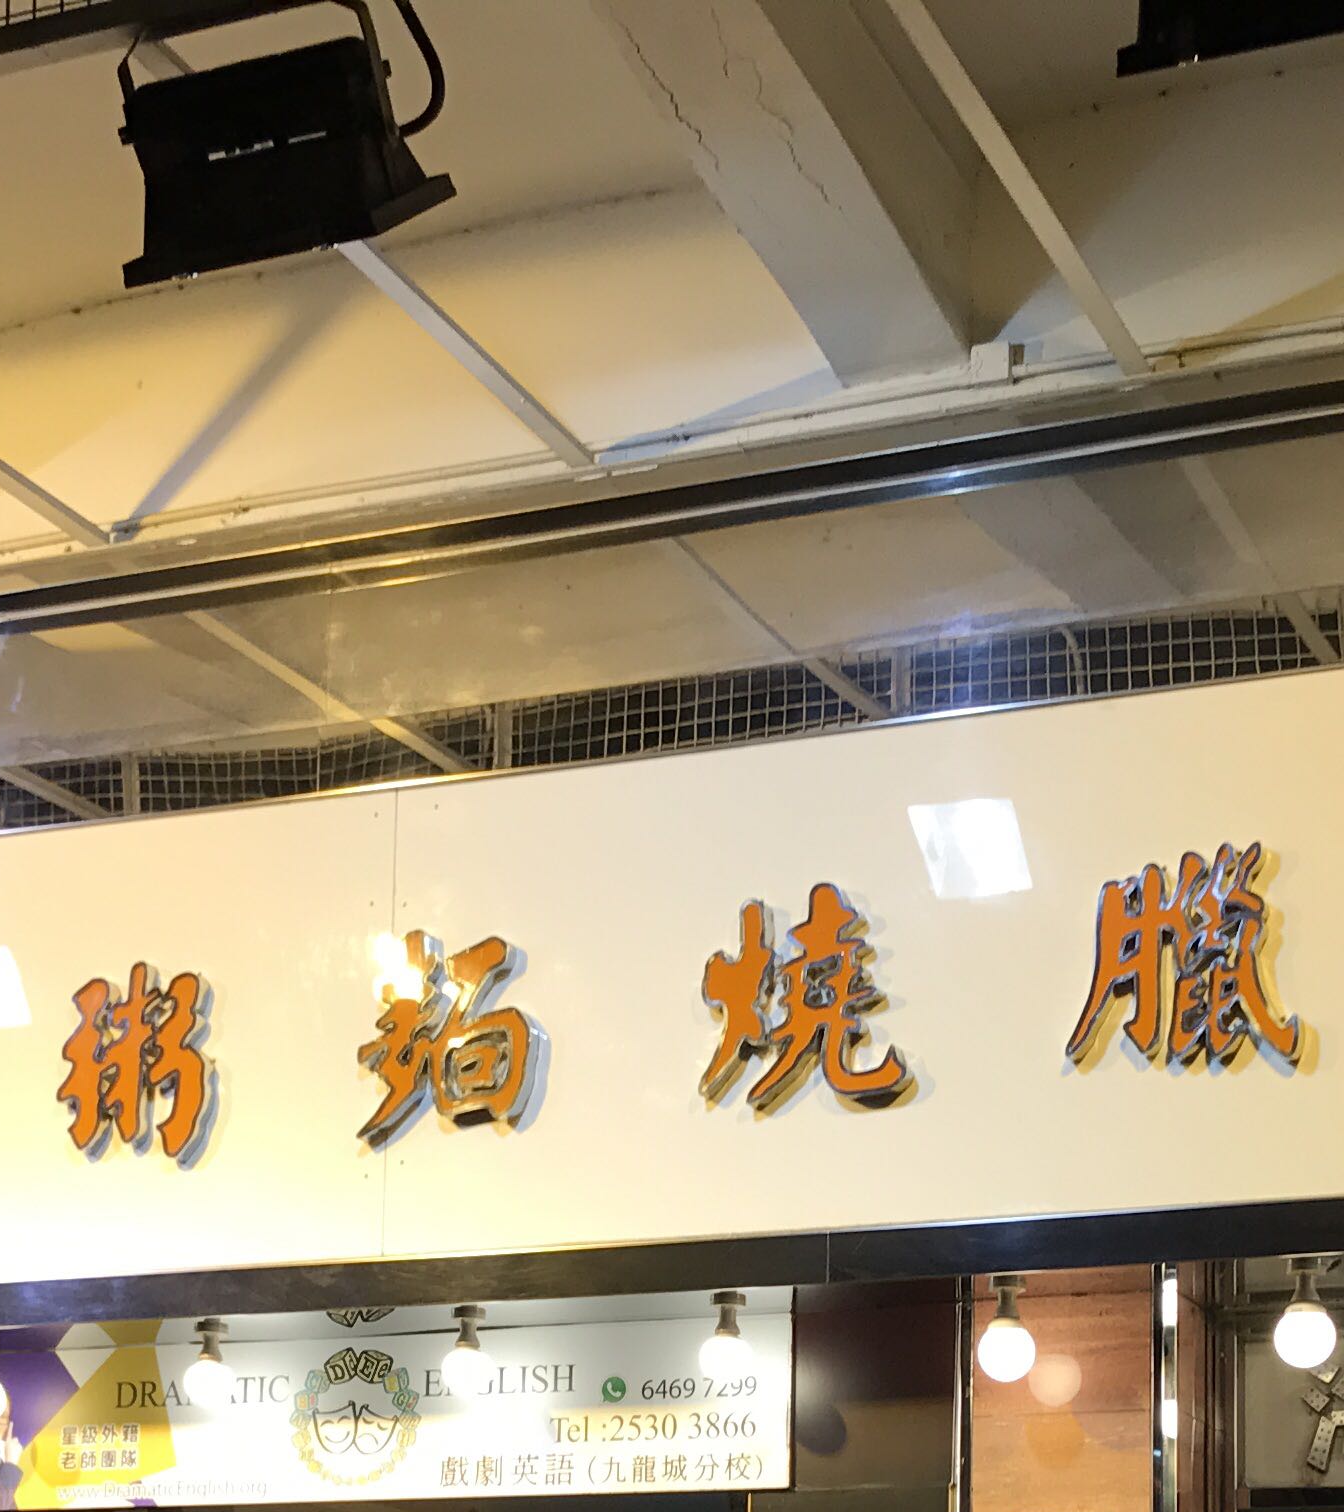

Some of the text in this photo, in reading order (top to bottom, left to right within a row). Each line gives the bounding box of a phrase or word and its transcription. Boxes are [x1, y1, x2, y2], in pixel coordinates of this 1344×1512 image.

[115, 1363, 577, 1409] DRATIC ELISH
[640, 1377, 696, 1400] 6469
[61, 1424, 139, 1446] 星級外籍
[550, 1415, 589, 1443] Tel
[687, 1411, 756, 1440] 3866
[60, 1450, 138, 1470] 老師團隊
